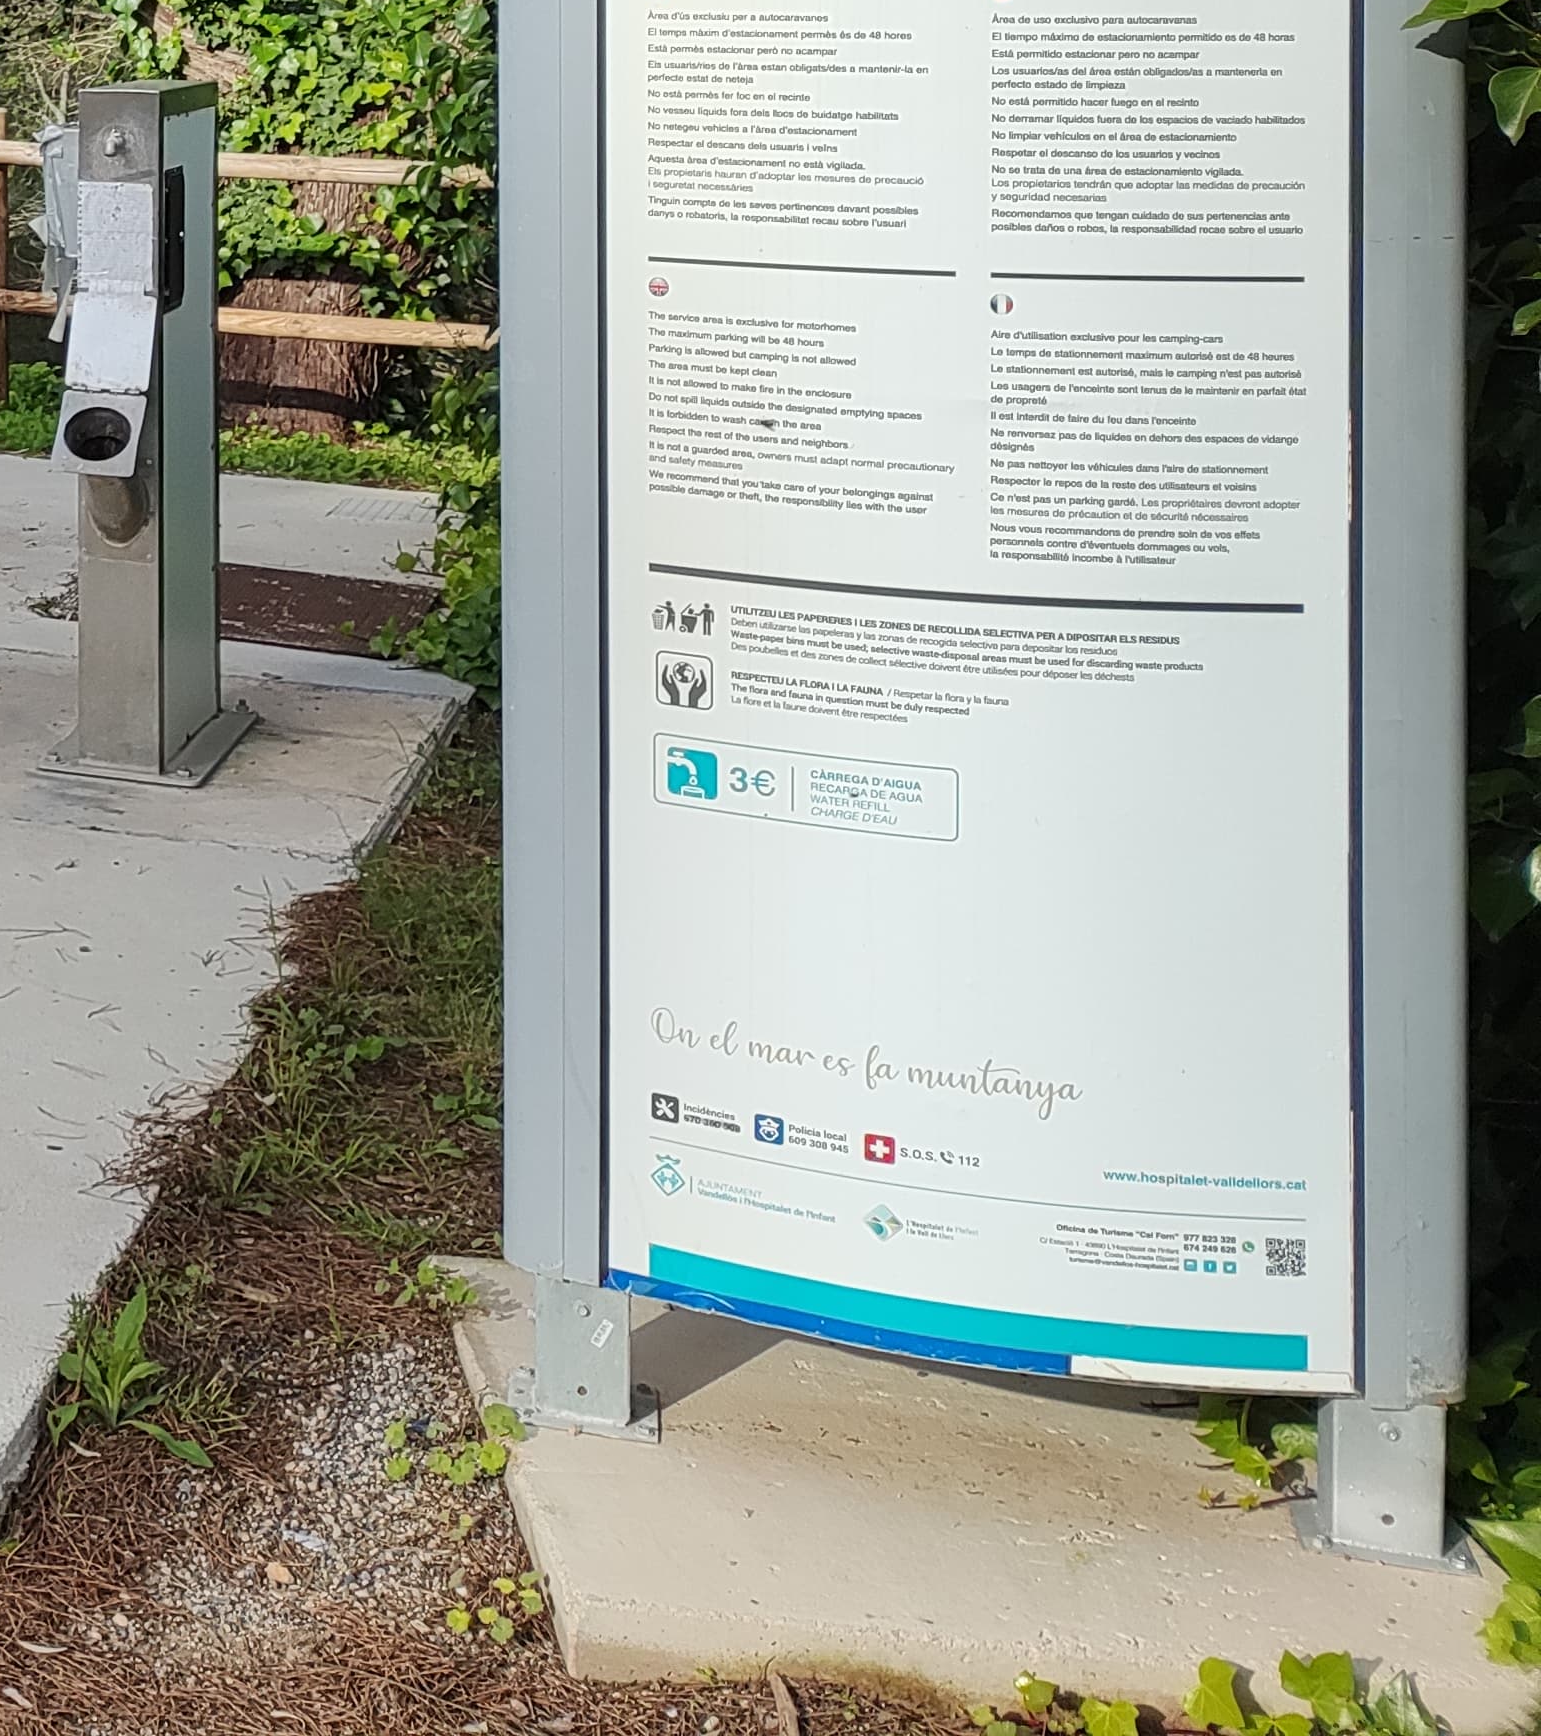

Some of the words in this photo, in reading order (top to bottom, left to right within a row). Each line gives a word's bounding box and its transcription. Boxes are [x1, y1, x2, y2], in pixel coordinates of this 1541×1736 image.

[647, 9, 668, 19] Àrea
[671, 11, 690, 20] d'ús
[693, 12, 729, 20] exclusiu
[732, 14, 747, 22] per
[992, 13, 1015, 23] Área
[1018, 15, 1030, 23] de
[1054, 15, 1099, 24] exclusivo
[1102, 17, 1124, 26] para
[1127, 16, 1197, 24] autocaravanas
[648, 27, 656, 35] El
[659, 28, 686, 37] temps
[689, 28, 719, 36] màxim
[722, 29, 798, 38] d'estacionament
[801, 30, 836, 40] permès
[839, 30, 851, 38] és
[869, 31, 881, 39] 48
[884, 31, 911, 39] hores
[648, 310, 665, 320] The
[668, 314, 699, 322] service
[702, 316, 723, 324] area
[725, 316, 733, 324] is
[736, 318, 778, 327] exclusive
[781, 320, 793, 328] for
[797, 322, 856, 332] motorhomes
[648, 327, 665, 336] The
[668, 330, 711, 339] maximum
[714, 333, 748, 344] parking
[751, 335, 765, 343] will
[768, 336, 780, 344] be
[783, 337, 794, 345] 48
[797, 338, 824, 347] hours
[990, 330, 1010, 338] Aire
[1013, 331, 1067, 340] d'utilisation
[1070, 332, 1115, 341] exclusive
[1117, 335, 1139, 343] pour
[1142, 333, 1156, 342] les
[1158, 334, 1223, 345] camping-cars
[731, 605, 776, 617] UTILITZEU
[778, 611, 795, 619] LES
[797, 612, 852, 625] PAPERERES
[859, 619, 876, 627] LES
[879, 620, 910, 630] ZONES
[913, 623, 925, 632] DE
[928, 624, 980, 635] RECOLLIDA
[983, 628, 1034, 639] SELECTIVA
[1036, 631, 1055, 639] PER
[1057, 632, 1064, 640] A
[1066, 632, 1117, 642] DIPOSITAR
[1119, 635, 1137, 643] ELS
[730, 629, 783, 643] Waste-paper
[786, 635, 804, 645] bins
[807, 640, 829, 648] must
[831, 640, 842, 649] be
[844, 644, 868, 652] used;
[871, 645, 909, 655] selective
[911, 650, 979, 661] waste-disposal
[1009, 656, 1032, 664] must
[1034, 656, 1045, 664] be
[1047, 657, 1069, 666] used
[1072, 657, 1084, 666] for
[1086, 658, 1133, 670] discarding
[1135, 661, 1162, 669] waste
[1163, 661, 1203, 671] products
[731, 671, 783, 684] RESPECTEU
[785, 677, 797, 686] LA
[799, 679, 829, 689] FLORA
[837, 683, 848, 691] LA
[850, 685, 883, 695] FAUNA
[893, 689, 932, 699] Respetar
[935, 692, 942, 700] la
[945, 693, 964, 702] flora
[973, 695, 981, 703] la
[983, 696, 1009, 705] fauna
[731, 682, 747, 692] The
[749, 685, 768, 694] flora
[770, 689, 786, 697] and
[788, 689, 813, 700] fauna
[815, 693, 823, 701] in
[825, 696, 863, 705] question
[865, 700, 888, 708] must
[890, 701, 902, 709] be
[904, 702, 923, 713] duly
[925, 706, 969, 715] respected
[729, 767, 775, 796] 3€
[810, 769, 868, 785] CÀRREGA
[872, 777, 921, 790] D'AIGUA
[810, 782, 867, 797] RECARGA
[870, 789, 885, 799] DE
[889, 791, 922, 802] AGUA
[810, 794, 849, 806] WATER
[853, 799, 890, 812] REFILL
[811, 806, 859, 820] CHARGE
[862, 812, 897, 825] D'EAU
[650, 1007, 701, 1049] On
[710, 1021, 738, 1055] el
[748, 1040, 816, 1066] mar
[823, 1052, 856, 1077] es
[865, 1045, 900, 1090] fa
[907, 1059, 1083, 1121] muntanya
[683, 1104, 735, 1121] Incidències
[823, 1130, 847, 1142] local
[830, 1142, 849, 1154] 945
[900, 1147, 938, 1163] S.O.S.
[958, 1155, 980, 1167] 112
[697, 1178, 762, 1199] AJUNTAMENT
[1056, 1224, 1086, 1235] Oficina
[1088, 1227, 1098, 1235] de
[1101, 1228, 1133, 1237] Turisme
[1183, 1234, 1200, 1243] 977
